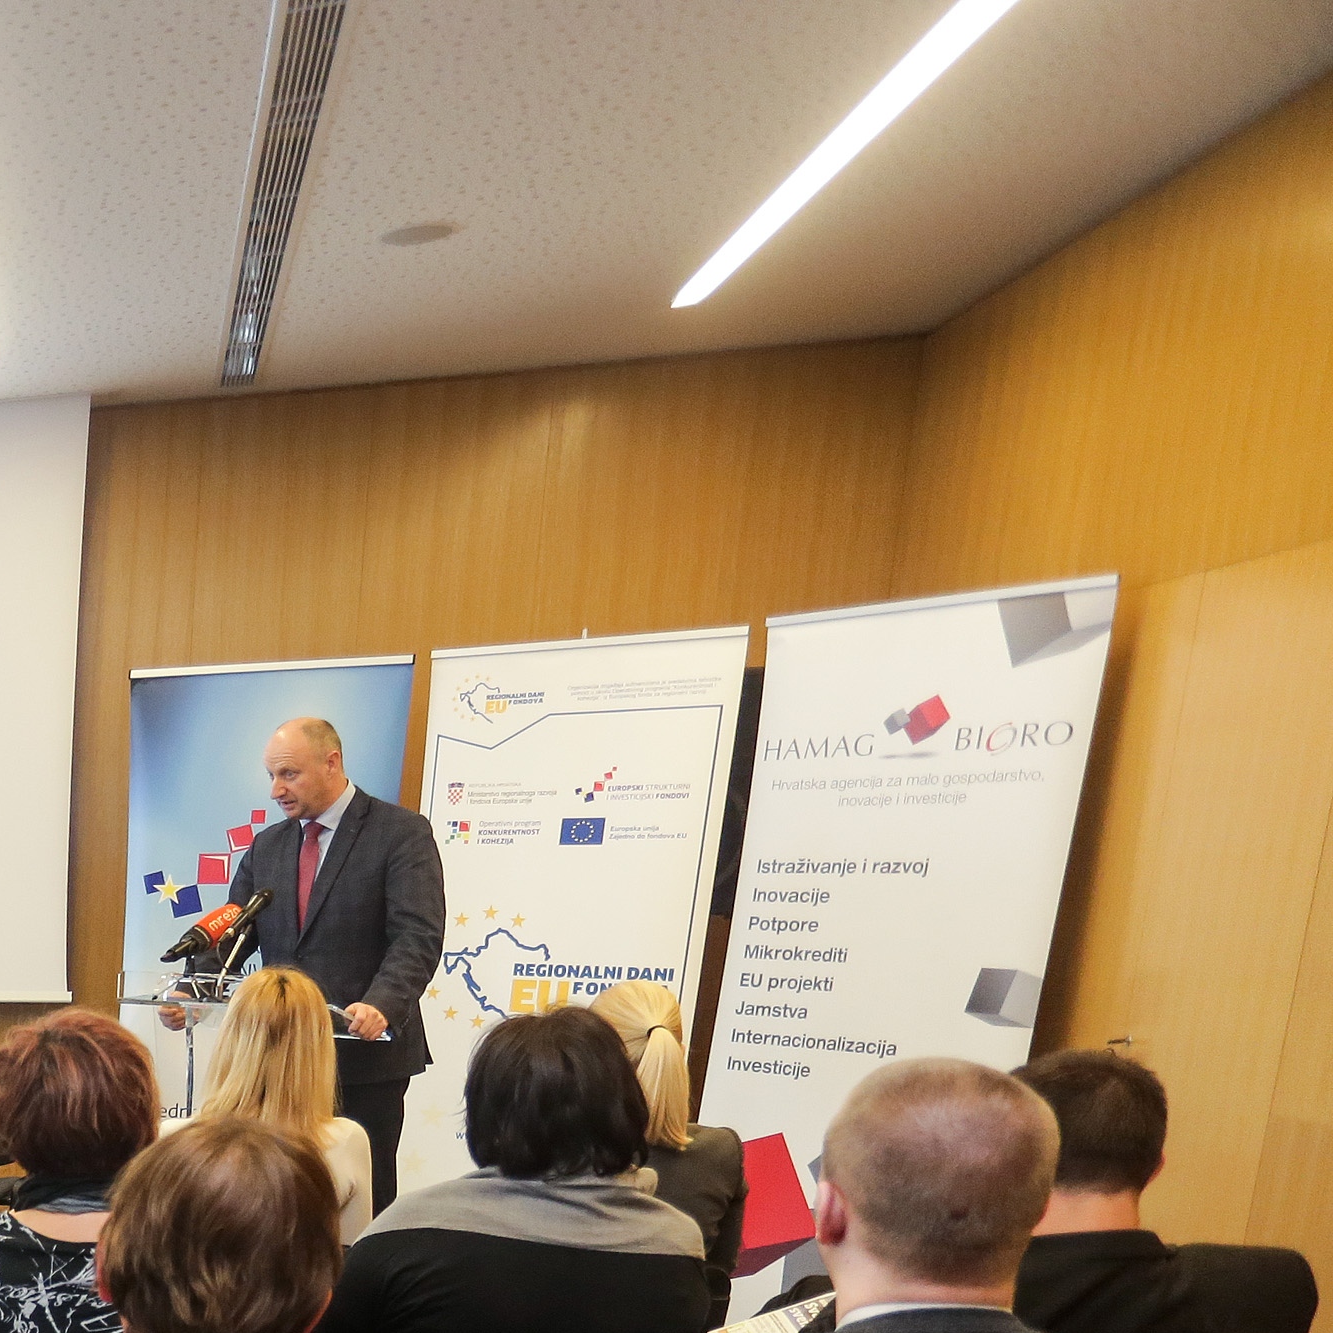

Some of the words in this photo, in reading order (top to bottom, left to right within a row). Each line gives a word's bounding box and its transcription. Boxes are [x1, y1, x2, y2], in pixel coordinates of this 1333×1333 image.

[486, 692, 527, 701] REGIONALNI
[485, 700, 508, 714] EU
[763, 733, 875, 762] HAMAG
[607, 784, 644, 792] EUROPSKI
[771, 776, 827, 791] Hrvatska
[830, 775, 883, 792] agencija
[886, 776, 903, 787] za
[905, 772, 939, 787] malo
[655, 792, 690, 800] FONDOVI
[837, 792, 893, 807] inovacije
[903, 790, 968, 805] investicije
[481, 838, 514, 846] KOHEZIJA
[756, 858, 857, 878] Istraživanje
[861, 858, 868, 874] i
[871, 858, 930, 878] razvoj
[752, 888, 831, 907] Inovacije
[747, 916, 820, 935] Potpore
[743, 944, 849, 963] Mikrokrediti
[513, 963, 622, 980] REGIONALNI
[626, 967, 675, 982] DANI
[739, 972, 763, 988] EU
[767, 975, 835, 993] projekti
[509, 979, 570, 1013] EU
[735, 1001, 809, 1019] Jamstva
[730, 1028, 898, 1058] Internacionalizacija
[726, 1056, 811, 1080] Investicije
